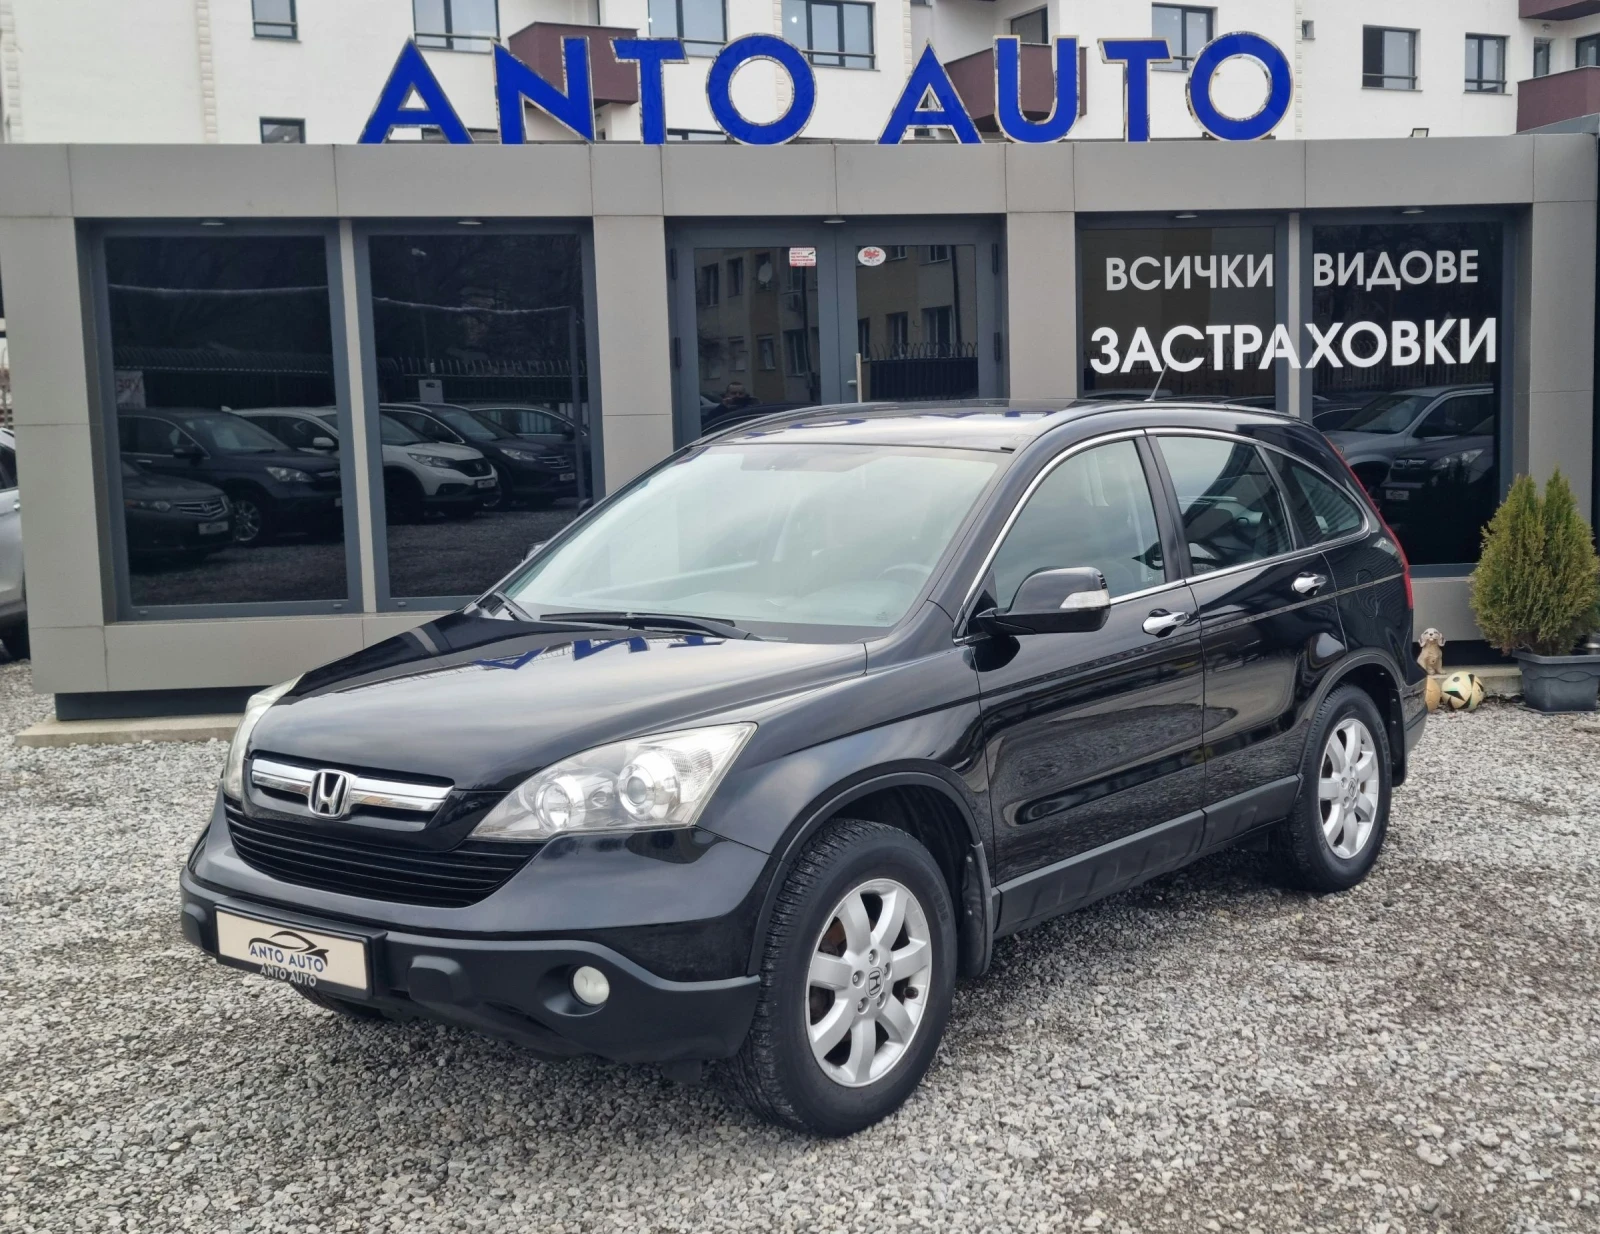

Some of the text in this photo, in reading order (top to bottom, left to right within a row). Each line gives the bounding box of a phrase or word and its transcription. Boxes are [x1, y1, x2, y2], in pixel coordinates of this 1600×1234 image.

[358, 31, 1294, 145] ANTO AUTO
[1106, 249, 1479, 292] ВСИЧКИ ВИДОВЕ
[1090, 317, 1497, 374] ЗАСТРАХОВКИ
